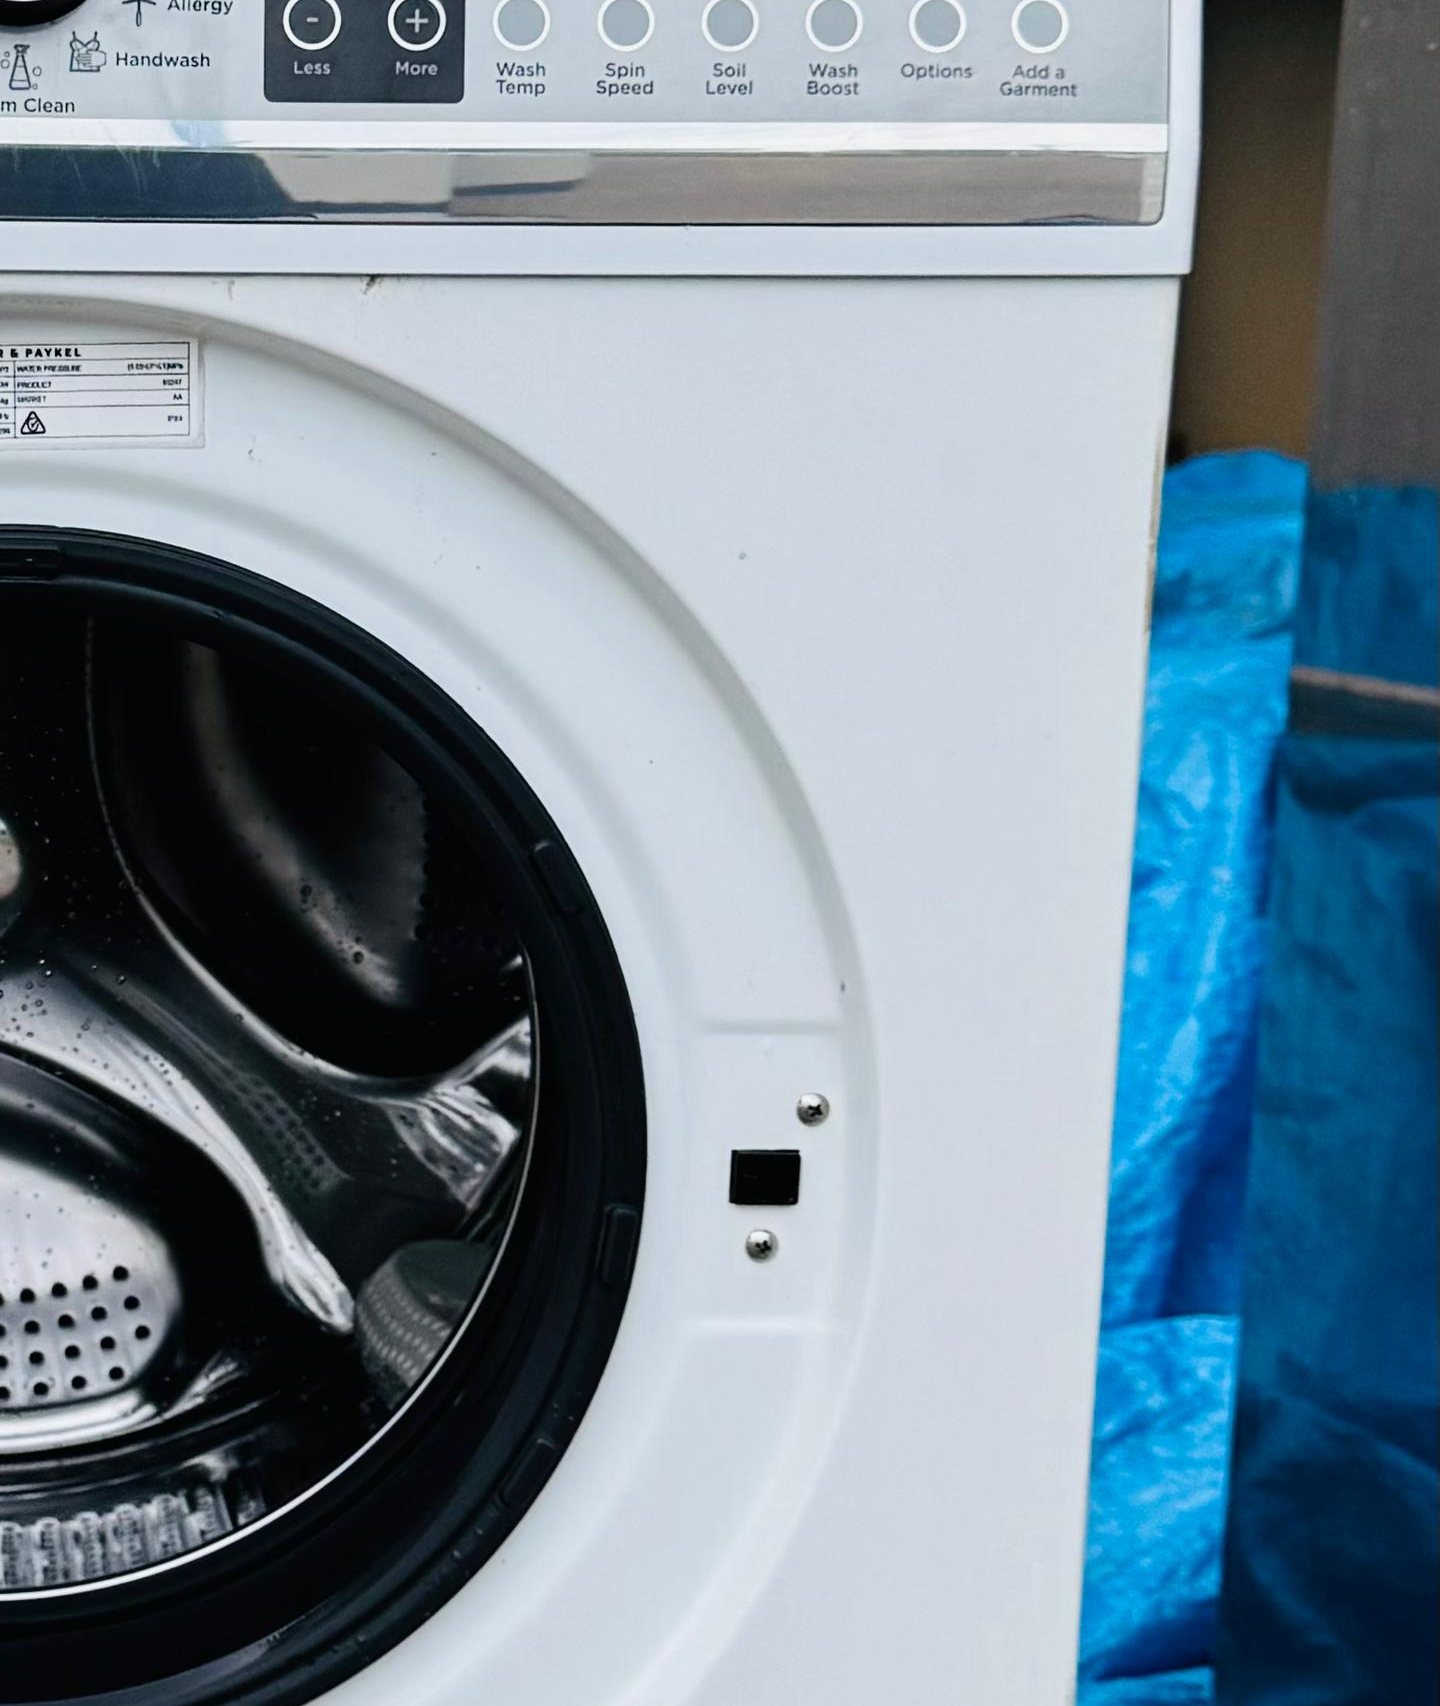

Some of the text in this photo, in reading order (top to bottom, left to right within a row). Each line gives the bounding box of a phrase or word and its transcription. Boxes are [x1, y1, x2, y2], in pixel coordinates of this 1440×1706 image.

[115, 51, 211, 68] Handwash
[293, 61, 331, 76] Less
[395, 62, 438, 76] More
[496, 62, 546, 77] Wash
[604, 62, 645, 80] Spin
[712, 63, 747, 79] Soil
[808, 63, 858, 79] Wash
[900, 64, 973, 82] Options
[1011, 64, 1066, 80] Add a
[495, 80, 546, 98] Temp
[595, 79, 654, 97] Speed
[705, 80, 753, 96] Level
[806, 80, 859, 96] Boost
[999, 81, 1077, 98] Garment
[23, 96, 76, 114] Clean
[24, 347, 82, 358] PAYKEL
